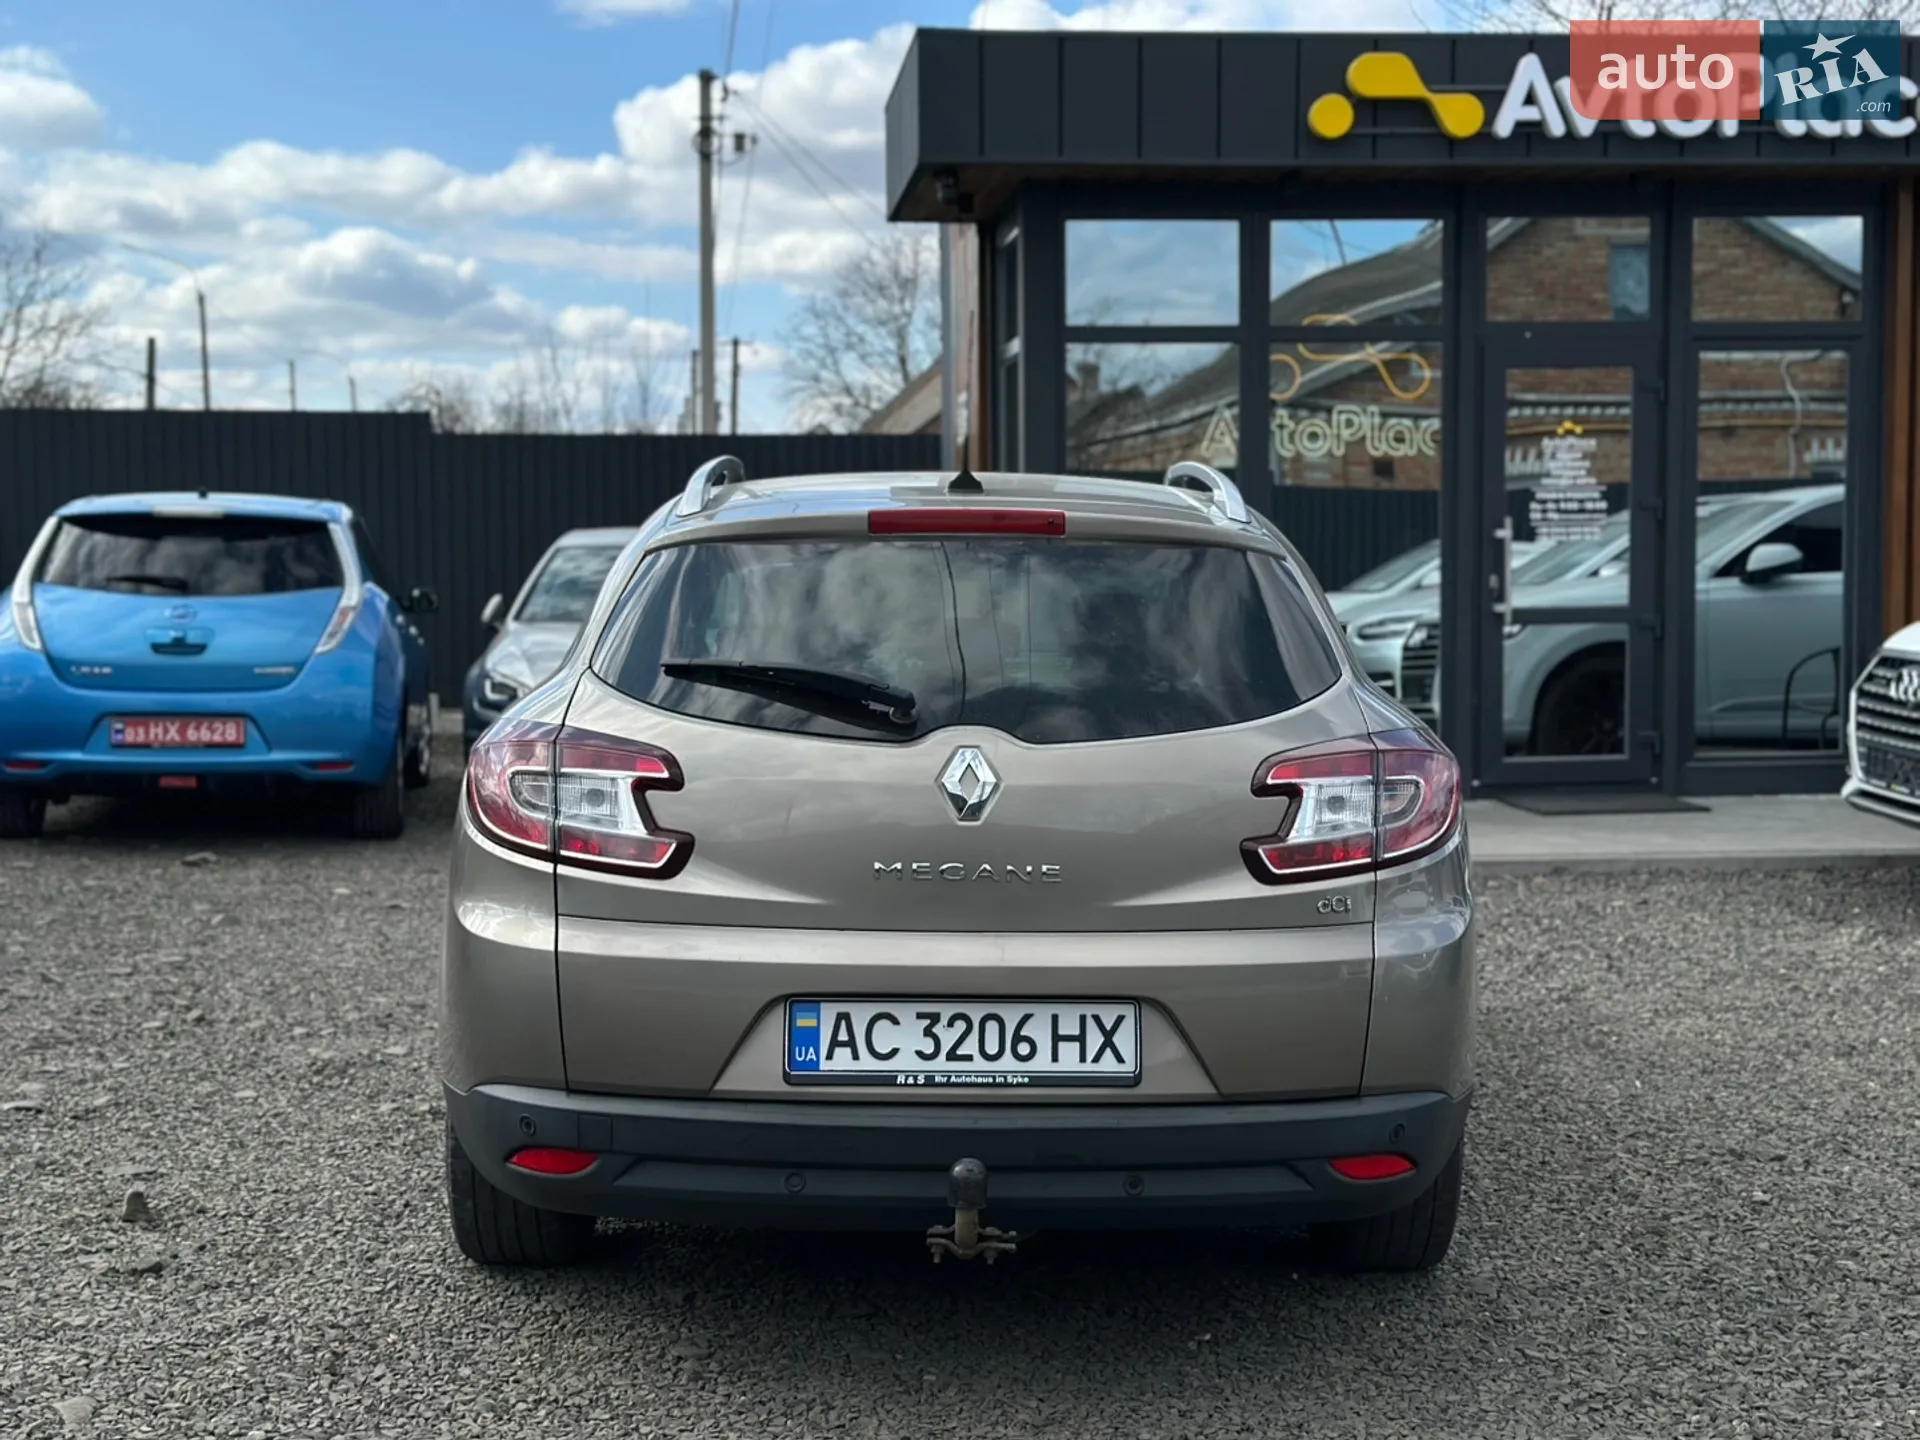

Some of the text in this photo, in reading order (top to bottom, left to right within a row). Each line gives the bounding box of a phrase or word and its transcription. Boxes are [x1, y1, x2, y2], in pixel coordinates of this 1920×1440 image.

[1491, 53, 1920, 138] AvtoPlac
[1201, 404, 1441, 457] AtoPlac
[149, 721, 180, 741] HX
[186, 721, 237, 741] 6628
[873, 861, 1062, 883] MEGANE
[825, 1012, 1126, 1064] AC 3206 HX
[795, 1046, 817, 1062] UA
[916, 1075, 926, 1085] S
[950, 1074, 994, 1083] Autohaus
[995, 1074, 1004, 1083] in
[1006, 1075, 1029, 1084] Syke
